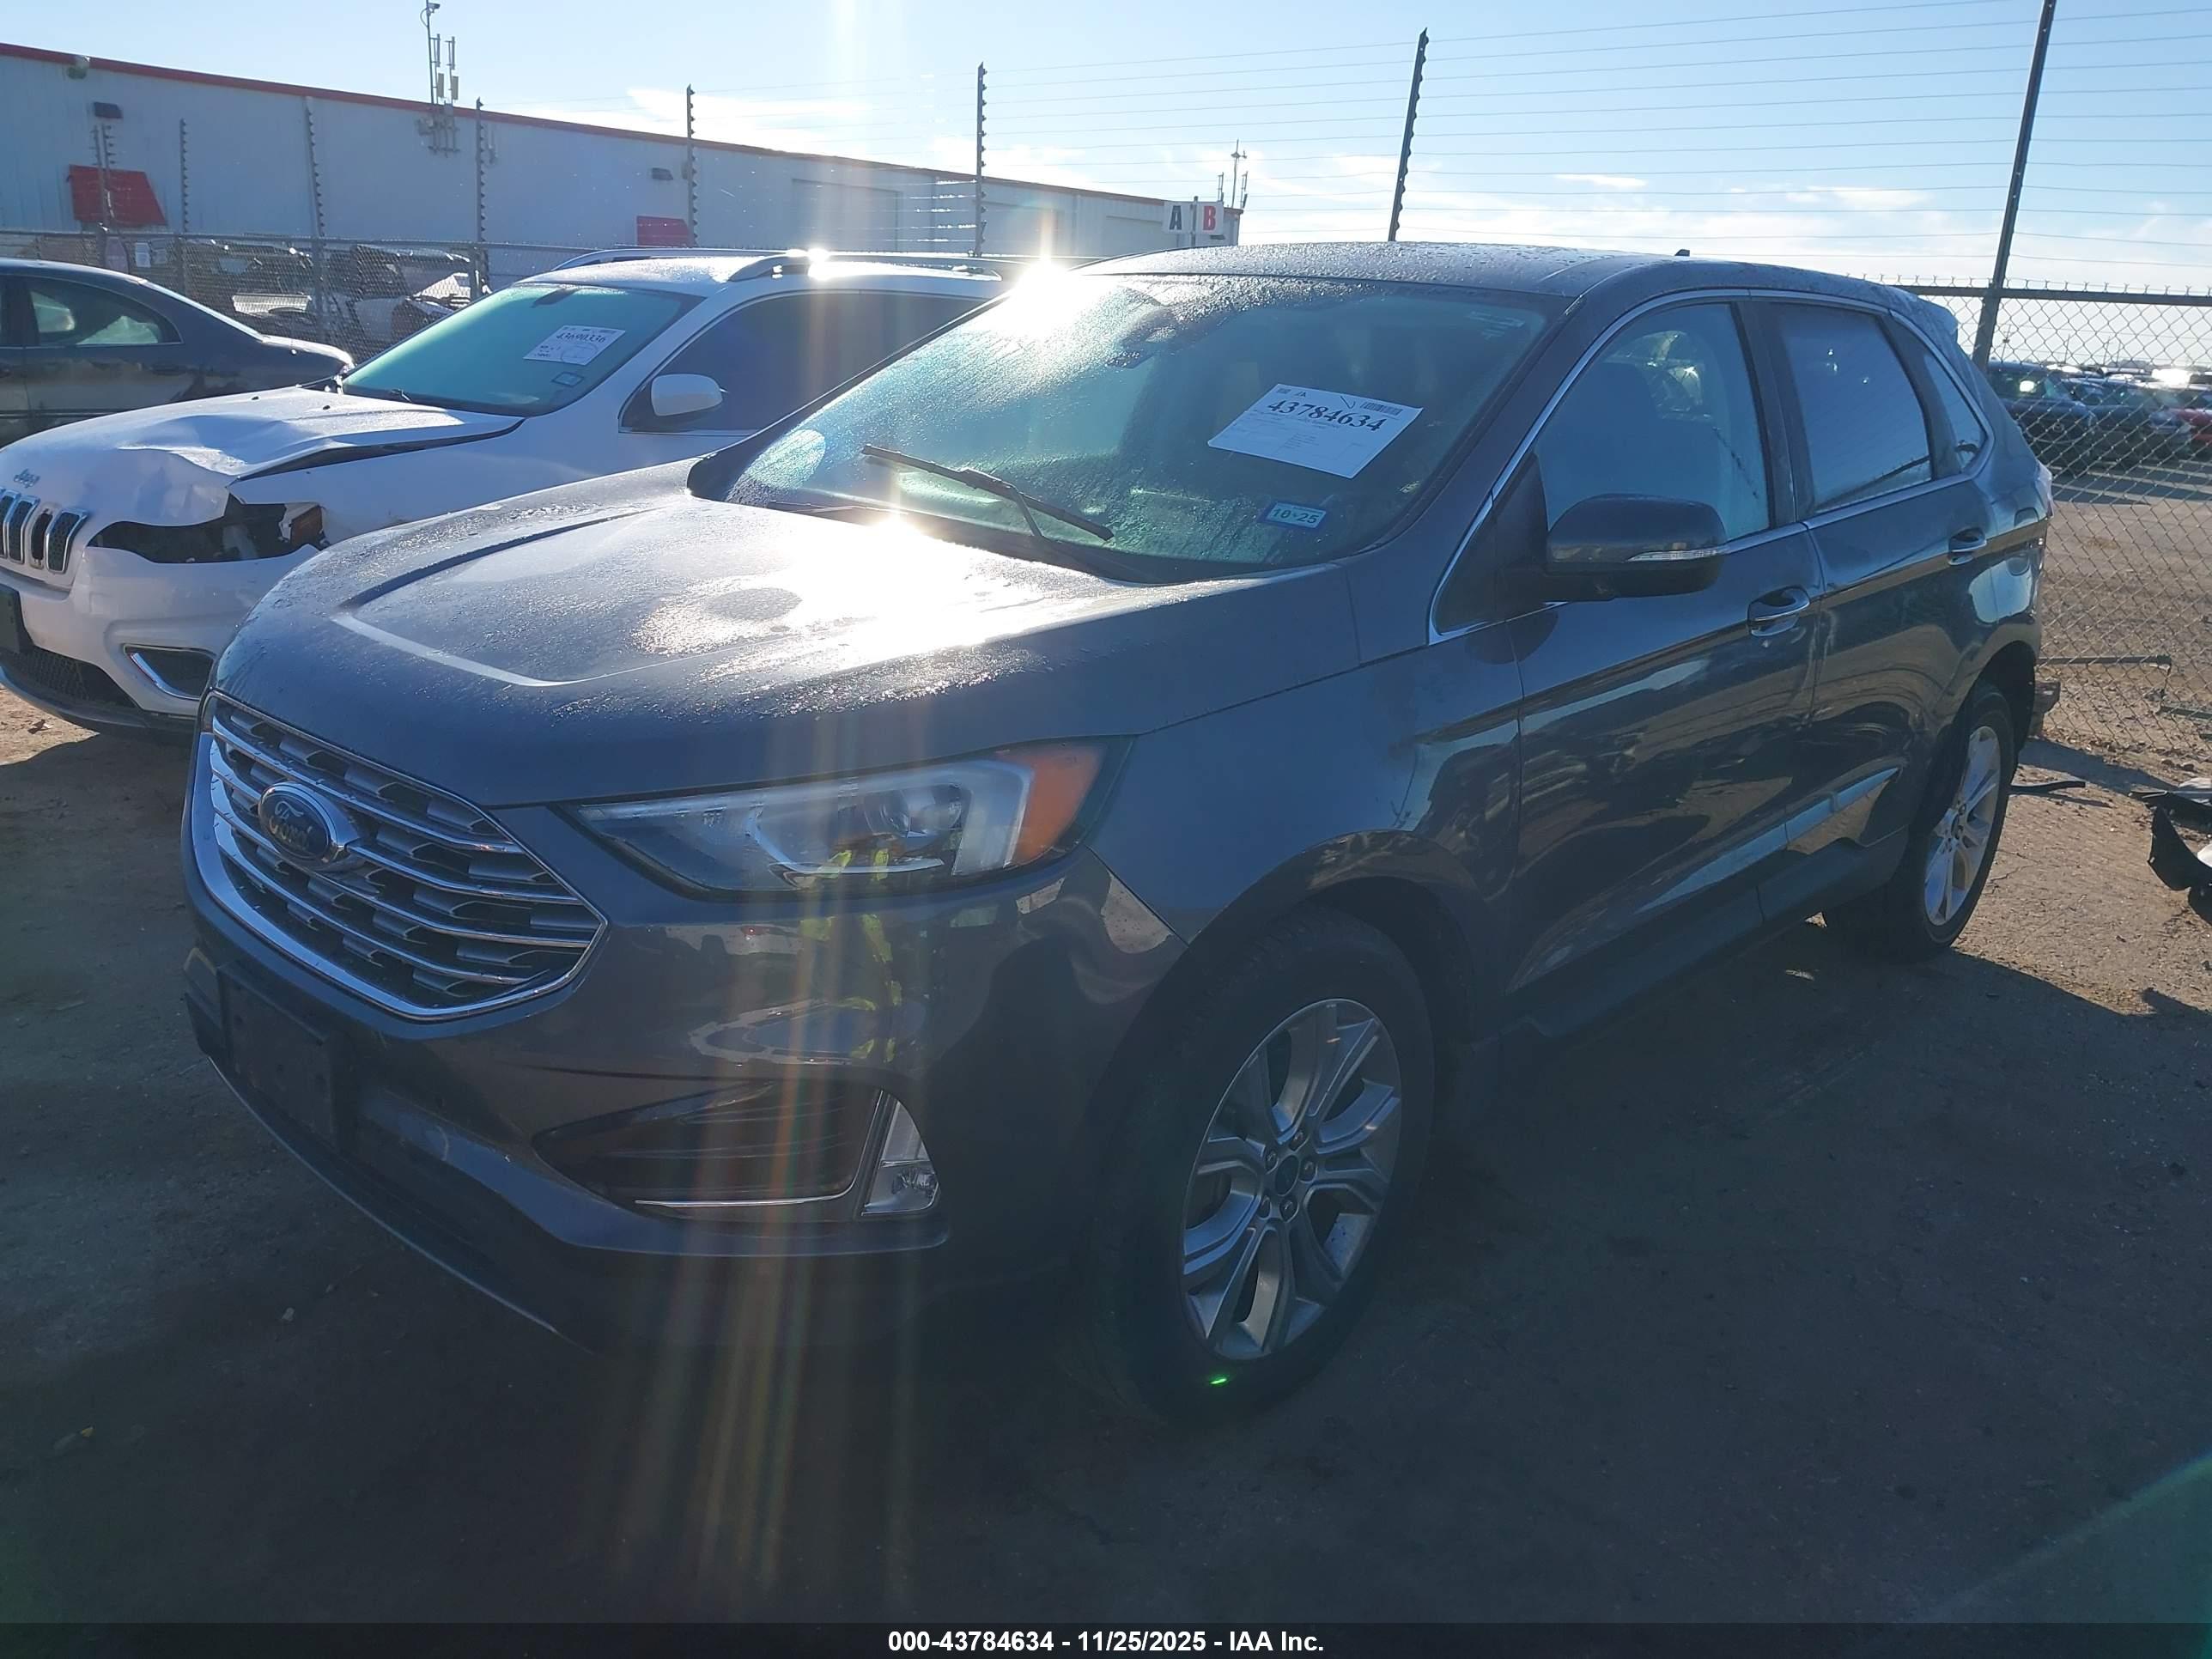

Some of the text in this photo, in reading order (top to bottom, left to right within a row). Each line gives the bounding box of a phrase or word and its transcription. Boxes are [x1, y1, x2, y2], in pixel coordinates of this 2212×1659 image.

[1169, 204, 1182, 230] A
[1202, 205, 1217, 231] B
[1267, 399, 1388, 431] 43784634
